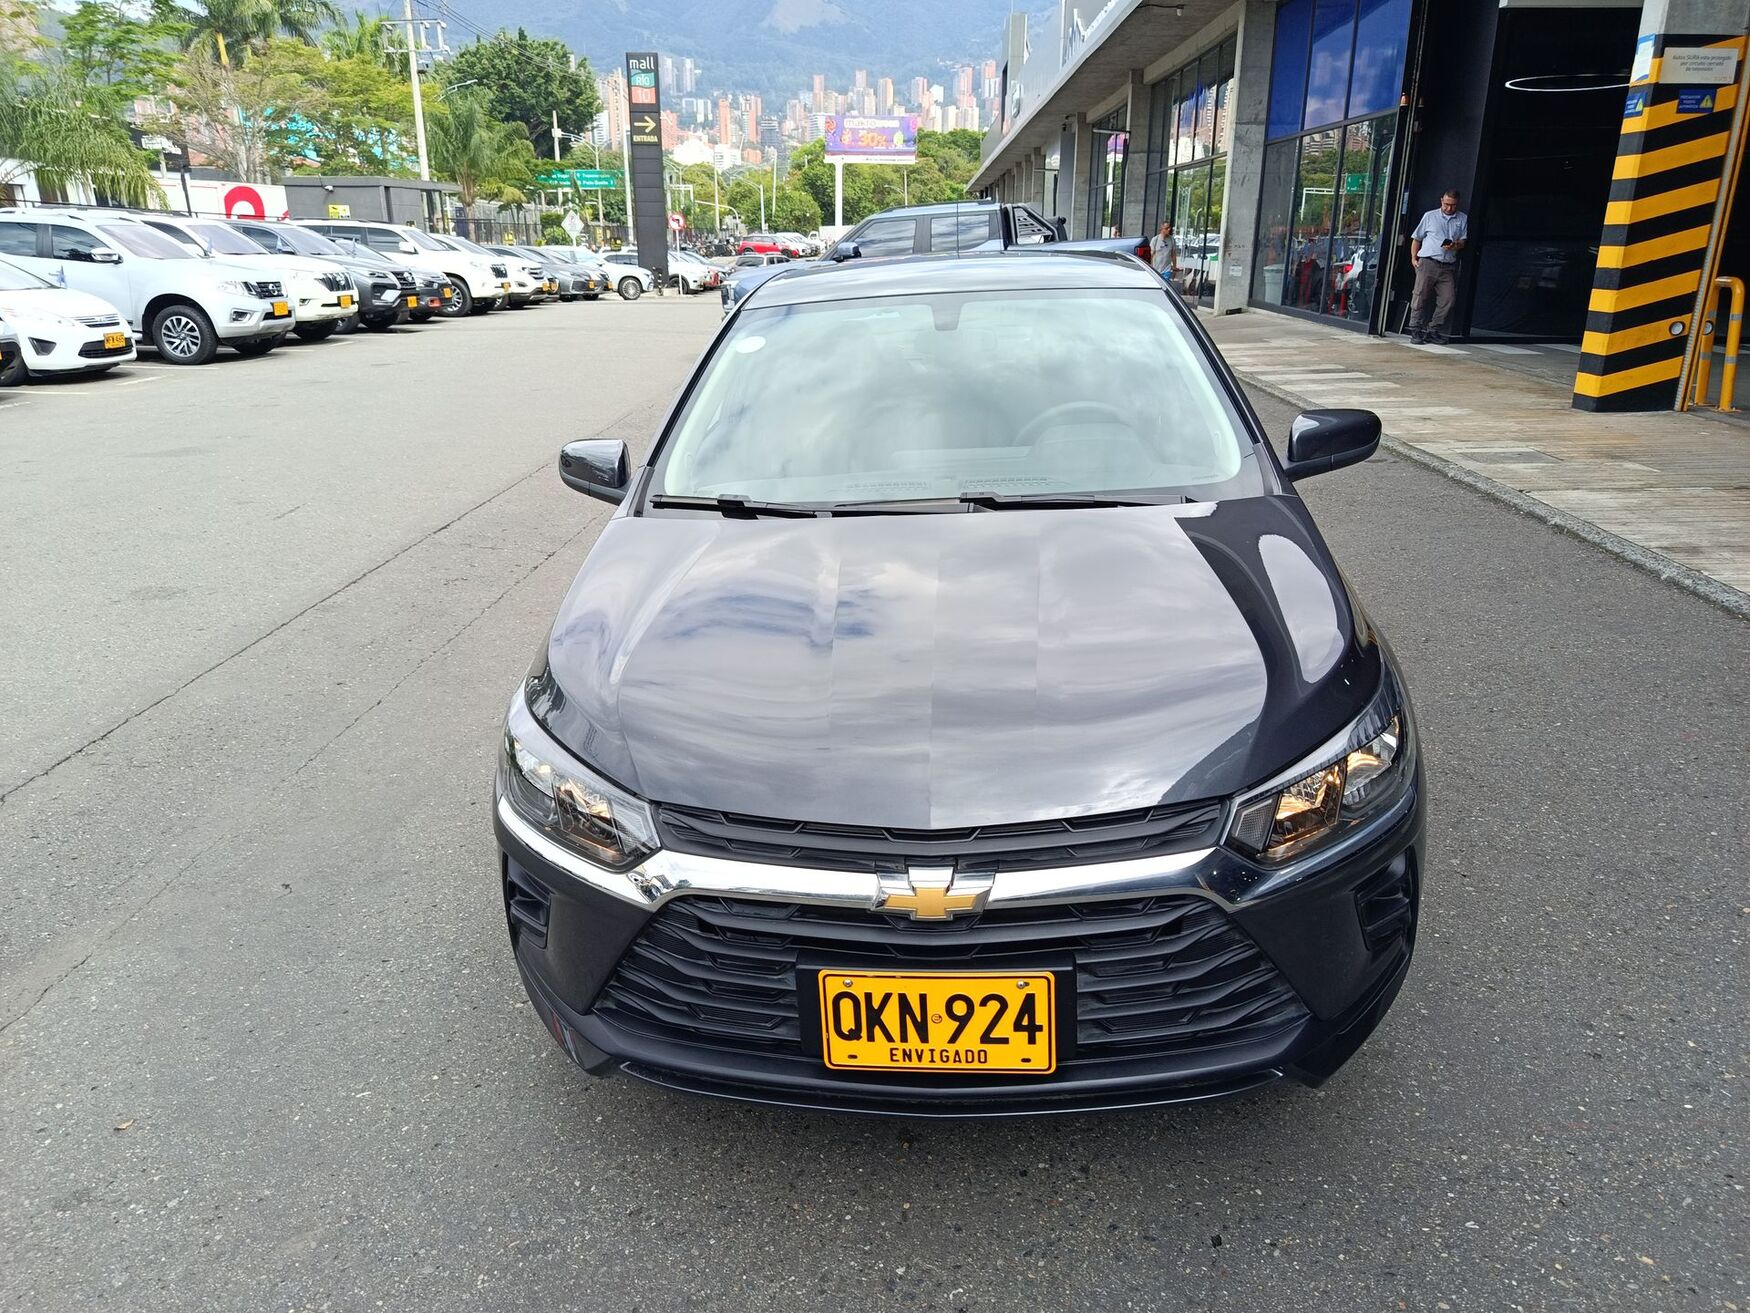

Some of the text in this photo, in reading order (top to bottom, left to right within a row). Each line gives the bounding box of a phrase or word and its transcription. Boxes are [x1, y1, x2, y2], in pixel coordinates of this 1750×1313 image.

[629, 56, 655, 70] mall
[831, 991, 1044, 1046] QKN 924
[889, 1047, 989, 1065] ENVIGADO
